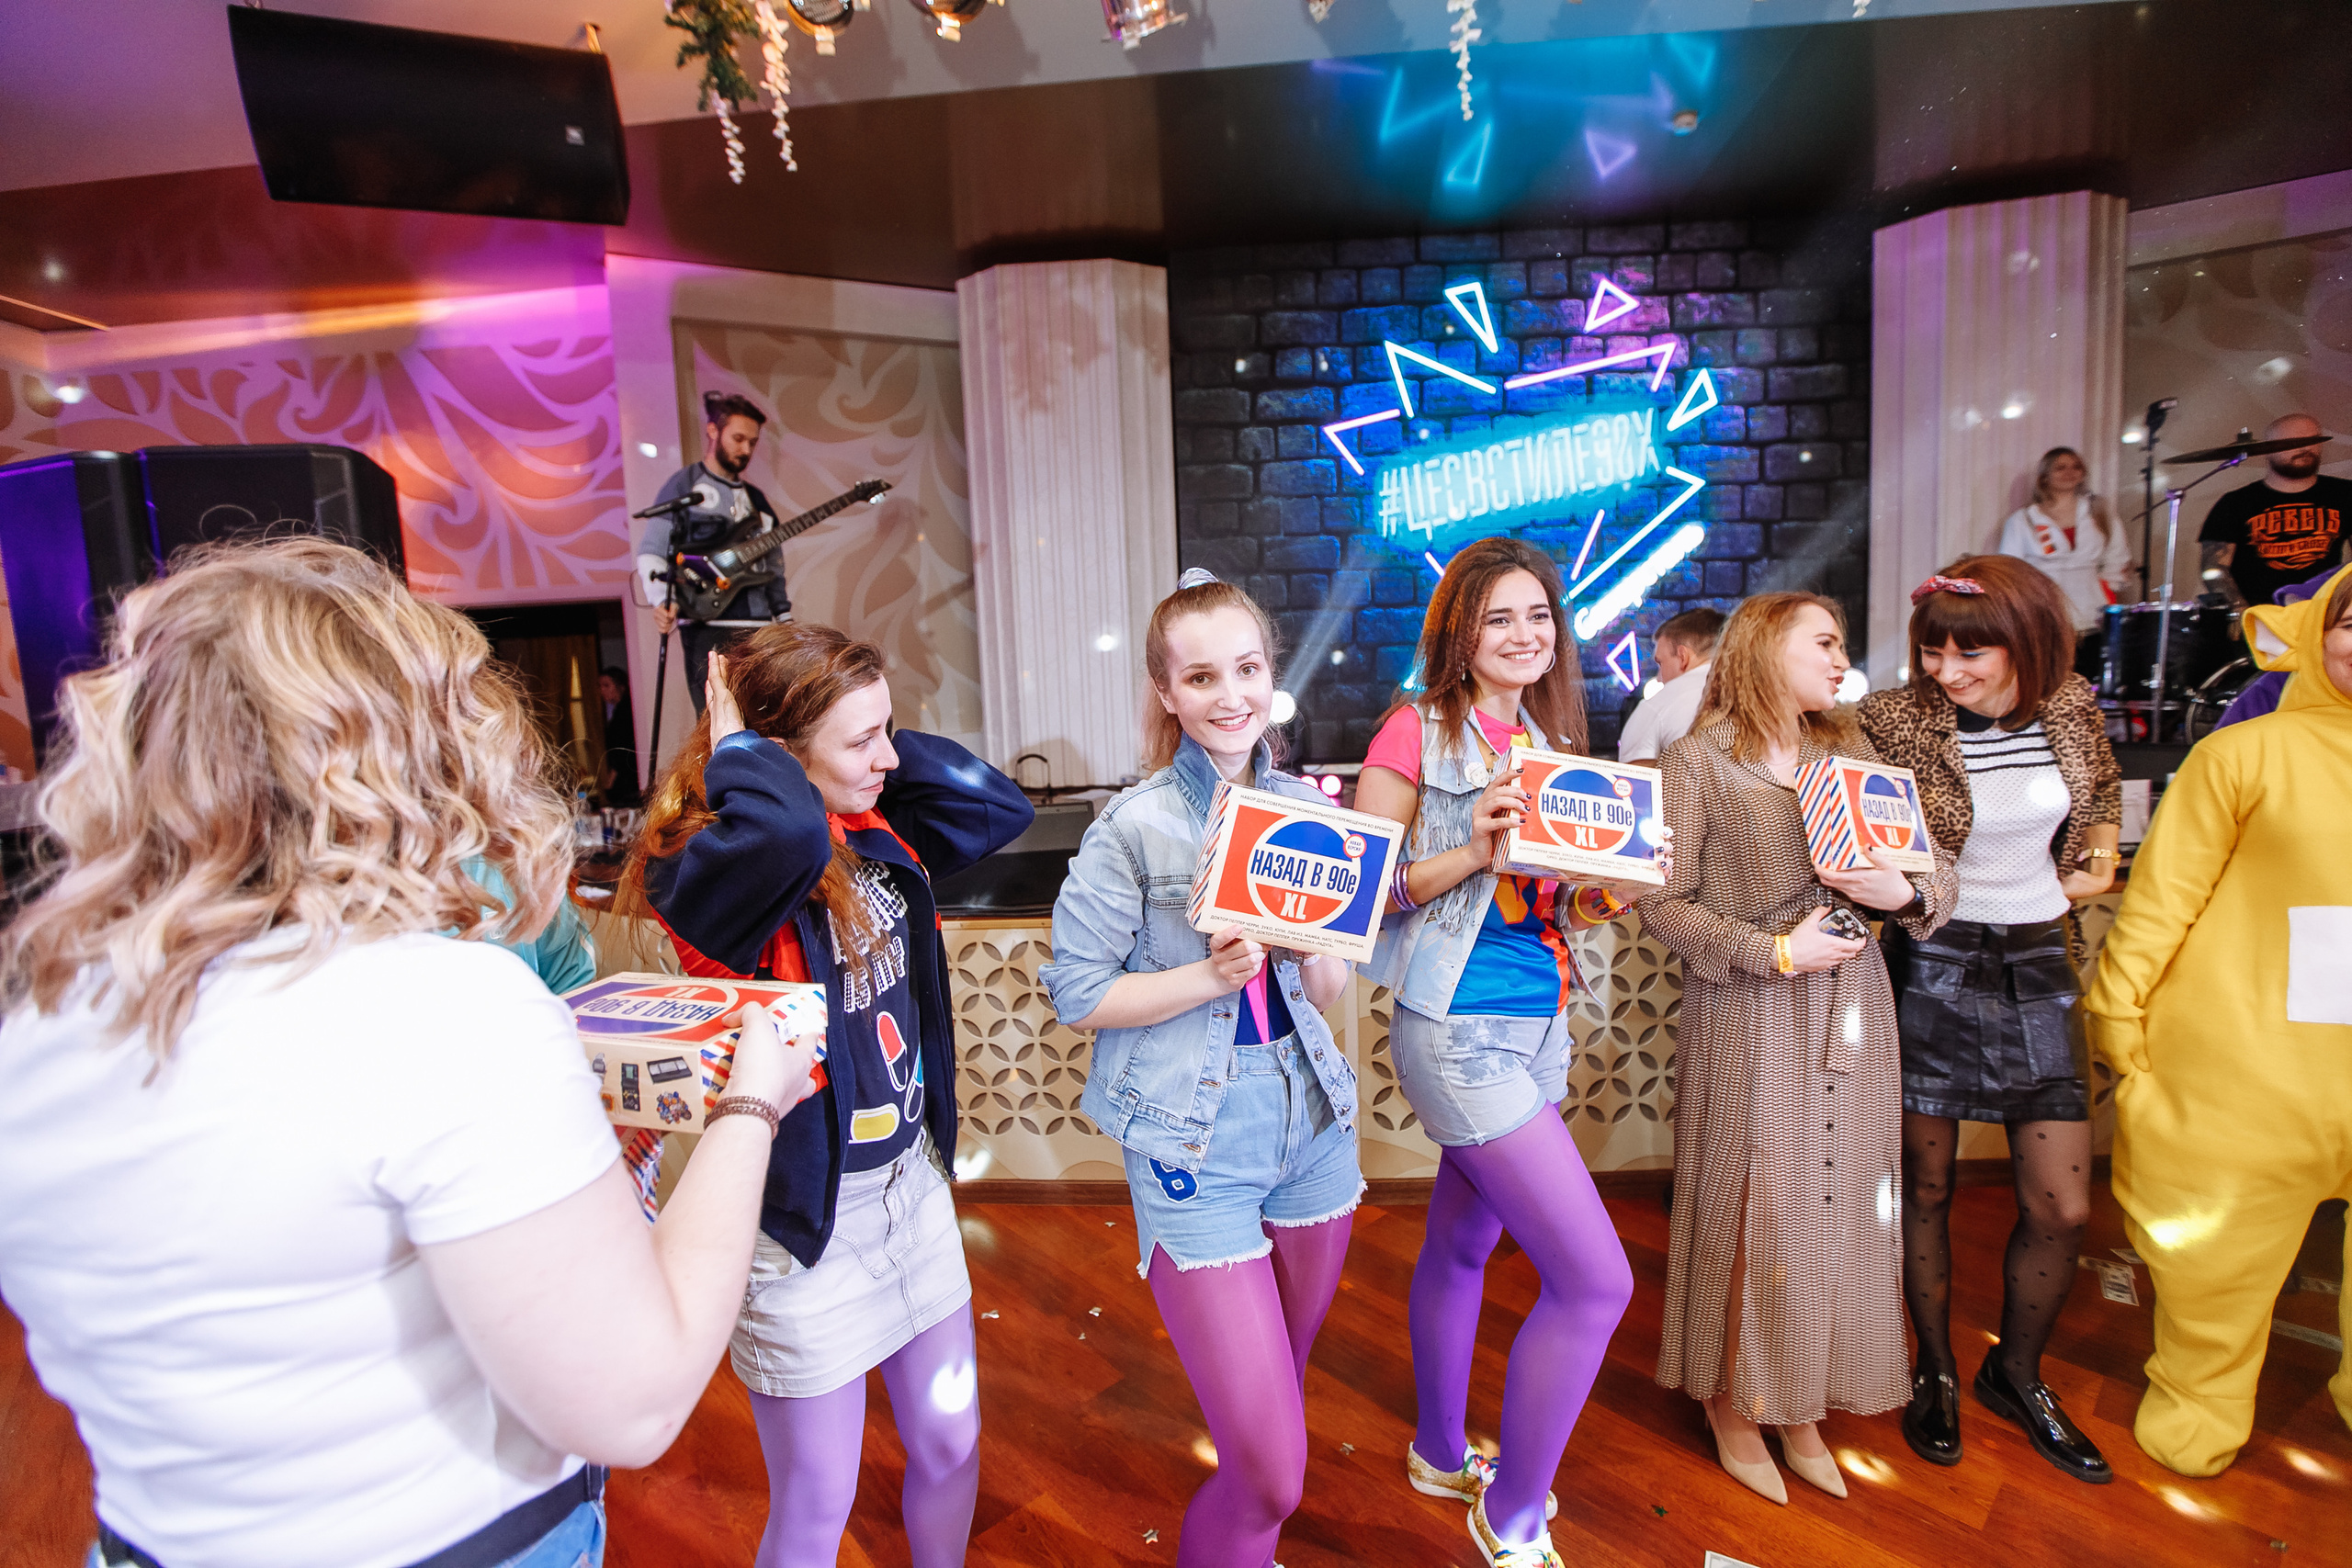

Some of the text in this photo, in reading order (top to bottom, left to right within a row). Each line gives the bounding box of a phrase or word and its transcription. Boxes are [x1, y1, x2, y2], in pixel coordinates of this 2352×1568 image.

[1541, 793, 1632, 826] НАЗАД В 90е
[1861, 798, 1891, 822] НАЗАД
[1892, 803, 1897, 820] В
[1575, 826, 1598, 849] XL
[1885, 828, 1901, 846] XL
[1250, 849, 1357, 895] НАЗАД В 90е
[1281, 891, 1306, 920] XL
[622, 1000, 651, 1015] В
[642, 999, 725, 1021] НАЗАД
